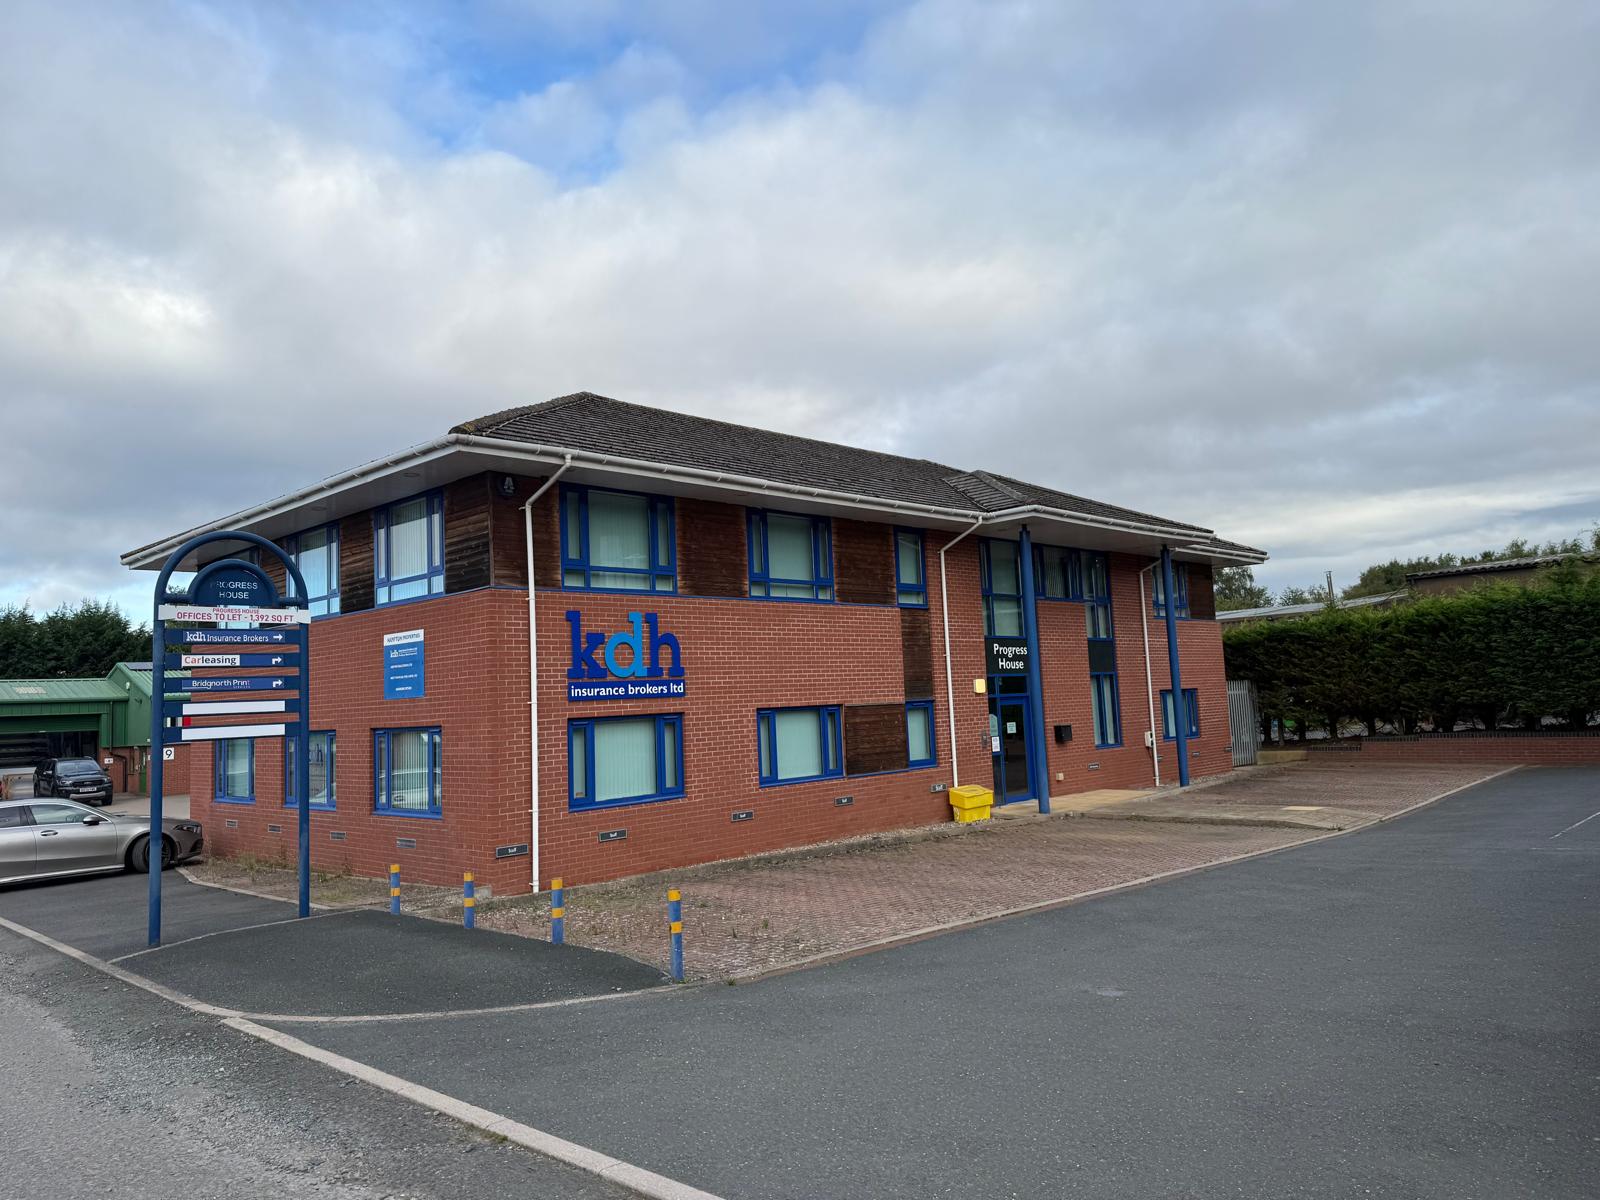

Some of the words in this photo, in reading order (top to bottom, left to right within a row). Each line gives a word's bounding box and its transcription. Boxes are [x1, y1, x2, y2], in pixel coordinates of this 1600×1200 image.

[219, 591, 249, 599] HOUSE
[176, 611, 212, 620] OFFICES
[214, 613, 225, 621] TO
[227, 613, 242, 621] LET
[249, 614, 270, 622] 1,392
[271, 615, 282, 623] SQ
[186, 631, 206, 642] kdh
[207, 634, 242, 642] Insurance
[243, 634, 269, 642] Brokers
[565, 610, 685, 679] kdh
[993, 643, 1028, 658] Progress
[184, 655, 237, 666] Carleasing
[998, 658, 1025, 670] House
[192, 679, 232, 690] Bridgnorth
[571, 686, 625, 697] insurance
[628, 683, 668, 695] brokers
[670, 682, 684, 693] ltd
[165, 749, 173, 758] 9
